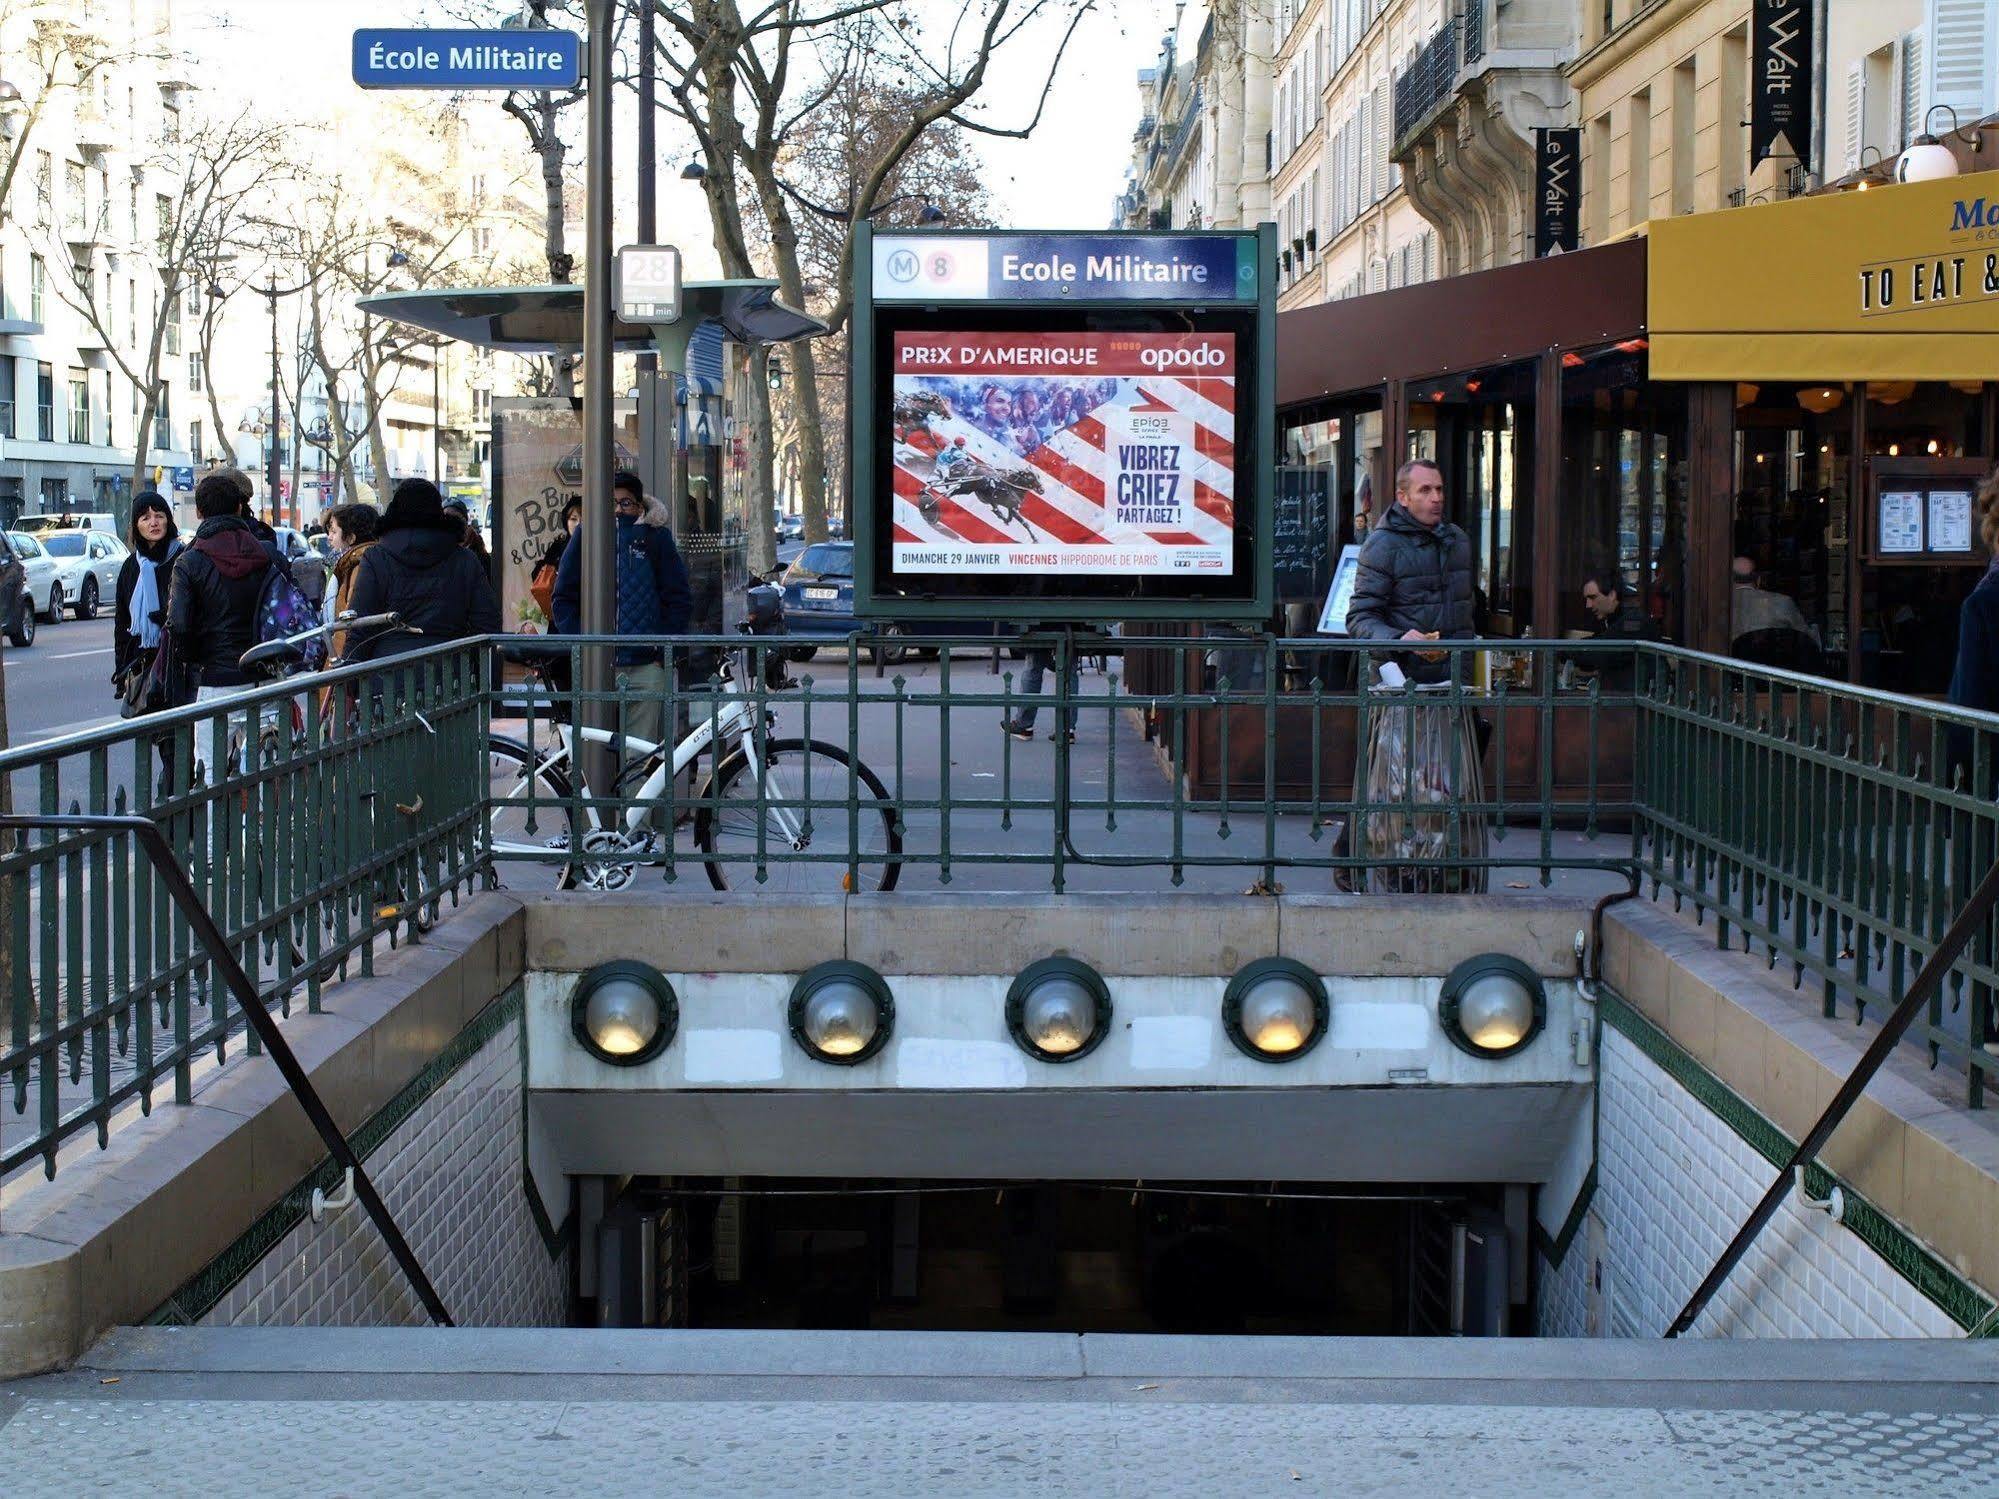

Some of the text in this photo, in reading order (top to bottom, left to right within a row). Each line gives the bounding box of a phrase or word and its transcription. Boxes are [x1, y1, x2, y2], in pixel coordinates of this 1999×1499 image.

[369, 41, 563, 70] École Militaire
[1766, 8, 1801, 95] Walt
[1546, 128, 1570, 154] Le
[1545, 153, 1571, 216] Walt
[630, 255, 667, 282] 28
[934, 257, 948, 277] 8
[1002, 254, 1208, 283] Ecole Militaire
[1859, 253, 1999, 311] TO EAT &
[655, 307, 673, 316] min
[901, 346, 953, 365] PRIX
[1140, 342, 1226, 372] opodo
[1118, 445, 1181, 471] VIBREZ
[1117, 473, 1180, 506] CRIEZ
[1117, 508, 1173, 523] PARTAGEZ
[901, 553, 1000, 565] DIMANCHE 29 JANVIER
[1008, 554, 1158, 566] VINCENNES HIPPODROME DE PARIS
